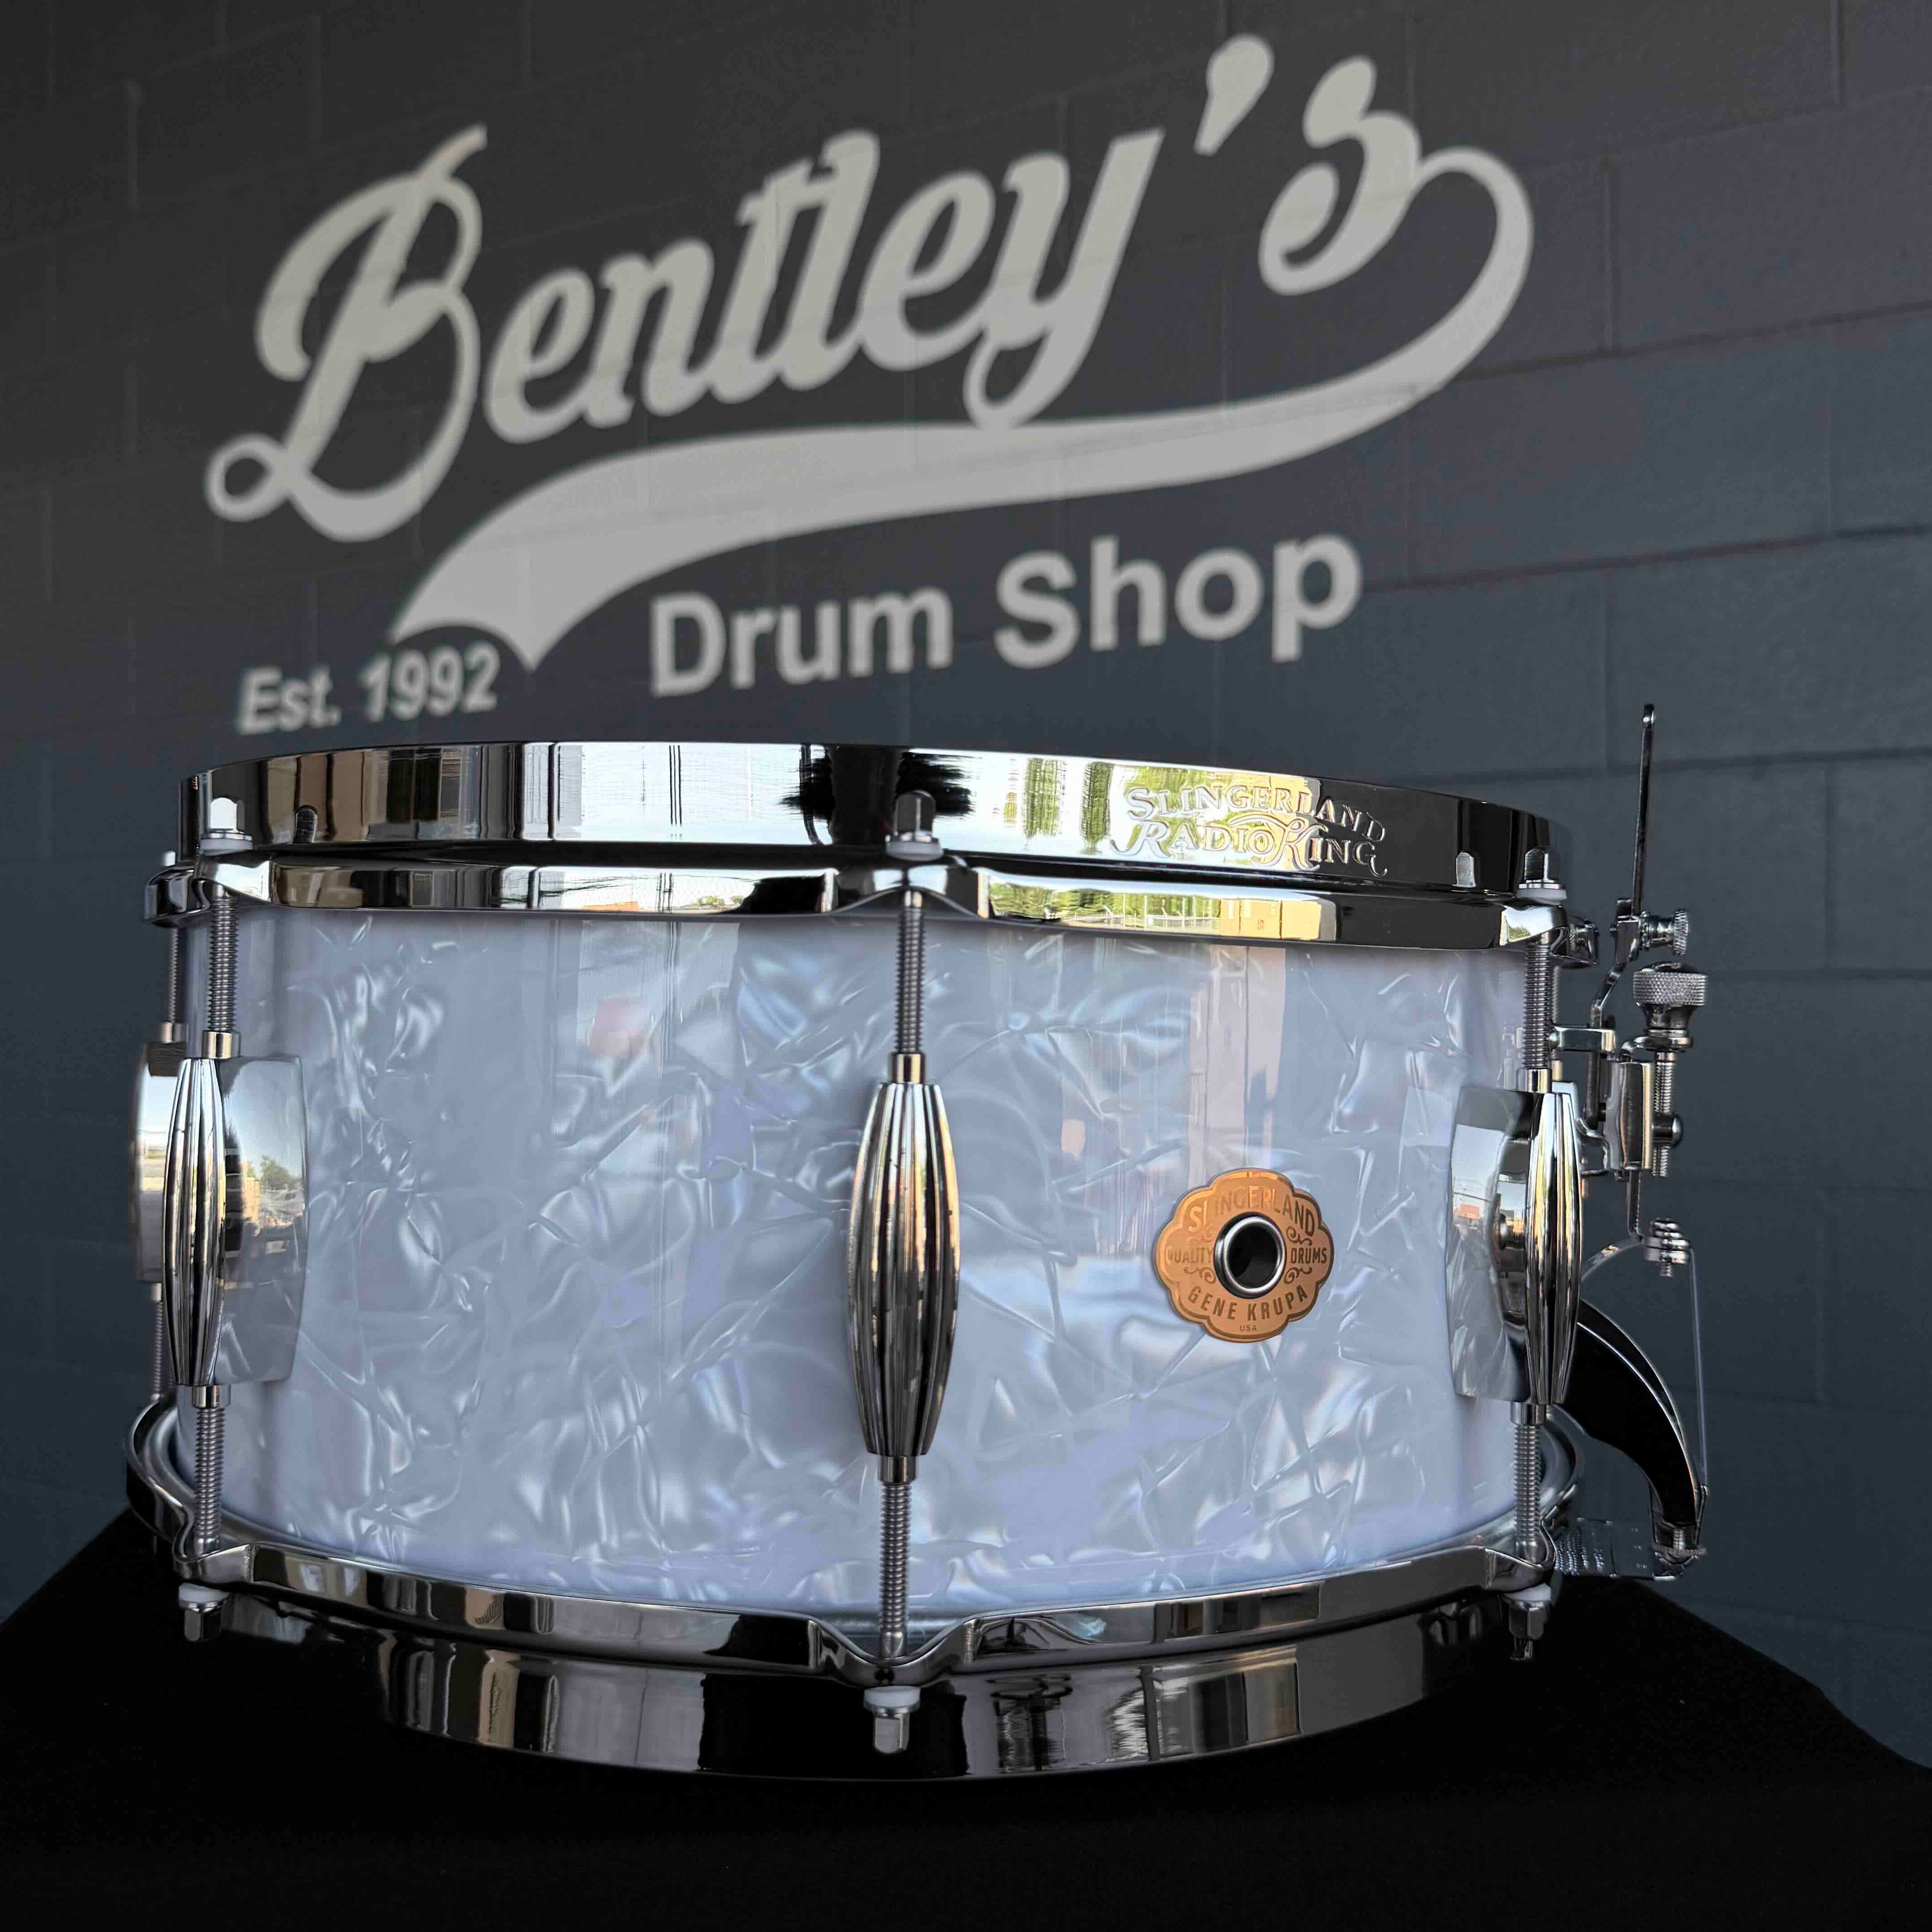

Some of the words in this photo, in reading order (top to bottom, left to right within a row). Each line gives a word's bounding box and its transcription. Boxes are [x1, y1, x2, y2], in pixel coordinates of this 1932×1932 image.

[205, 34, 1533, 543] Bentley's
[649, 586, 953, 697] Drum
[994, 532, 1362, 668] Shop
[236, 665, 341, 735] Est.
[363, 645, 500, 721] 1992
[1127, 785, 1387, 842] SLINGERLAND
[1109, 819, 1277, 859] RADIO
[1227, 812, 1388, 878] KING
[1188, 1184, 1315, 1237] SLINGERLAND
[1167, 1247, 1214, 1264] QUALITY
[1290, 1247, 1328, 1264] DRUMS
[1187, 1285, 1237, 1320] GENE
[1247, 1284, 1308, 1321] KRUPA
